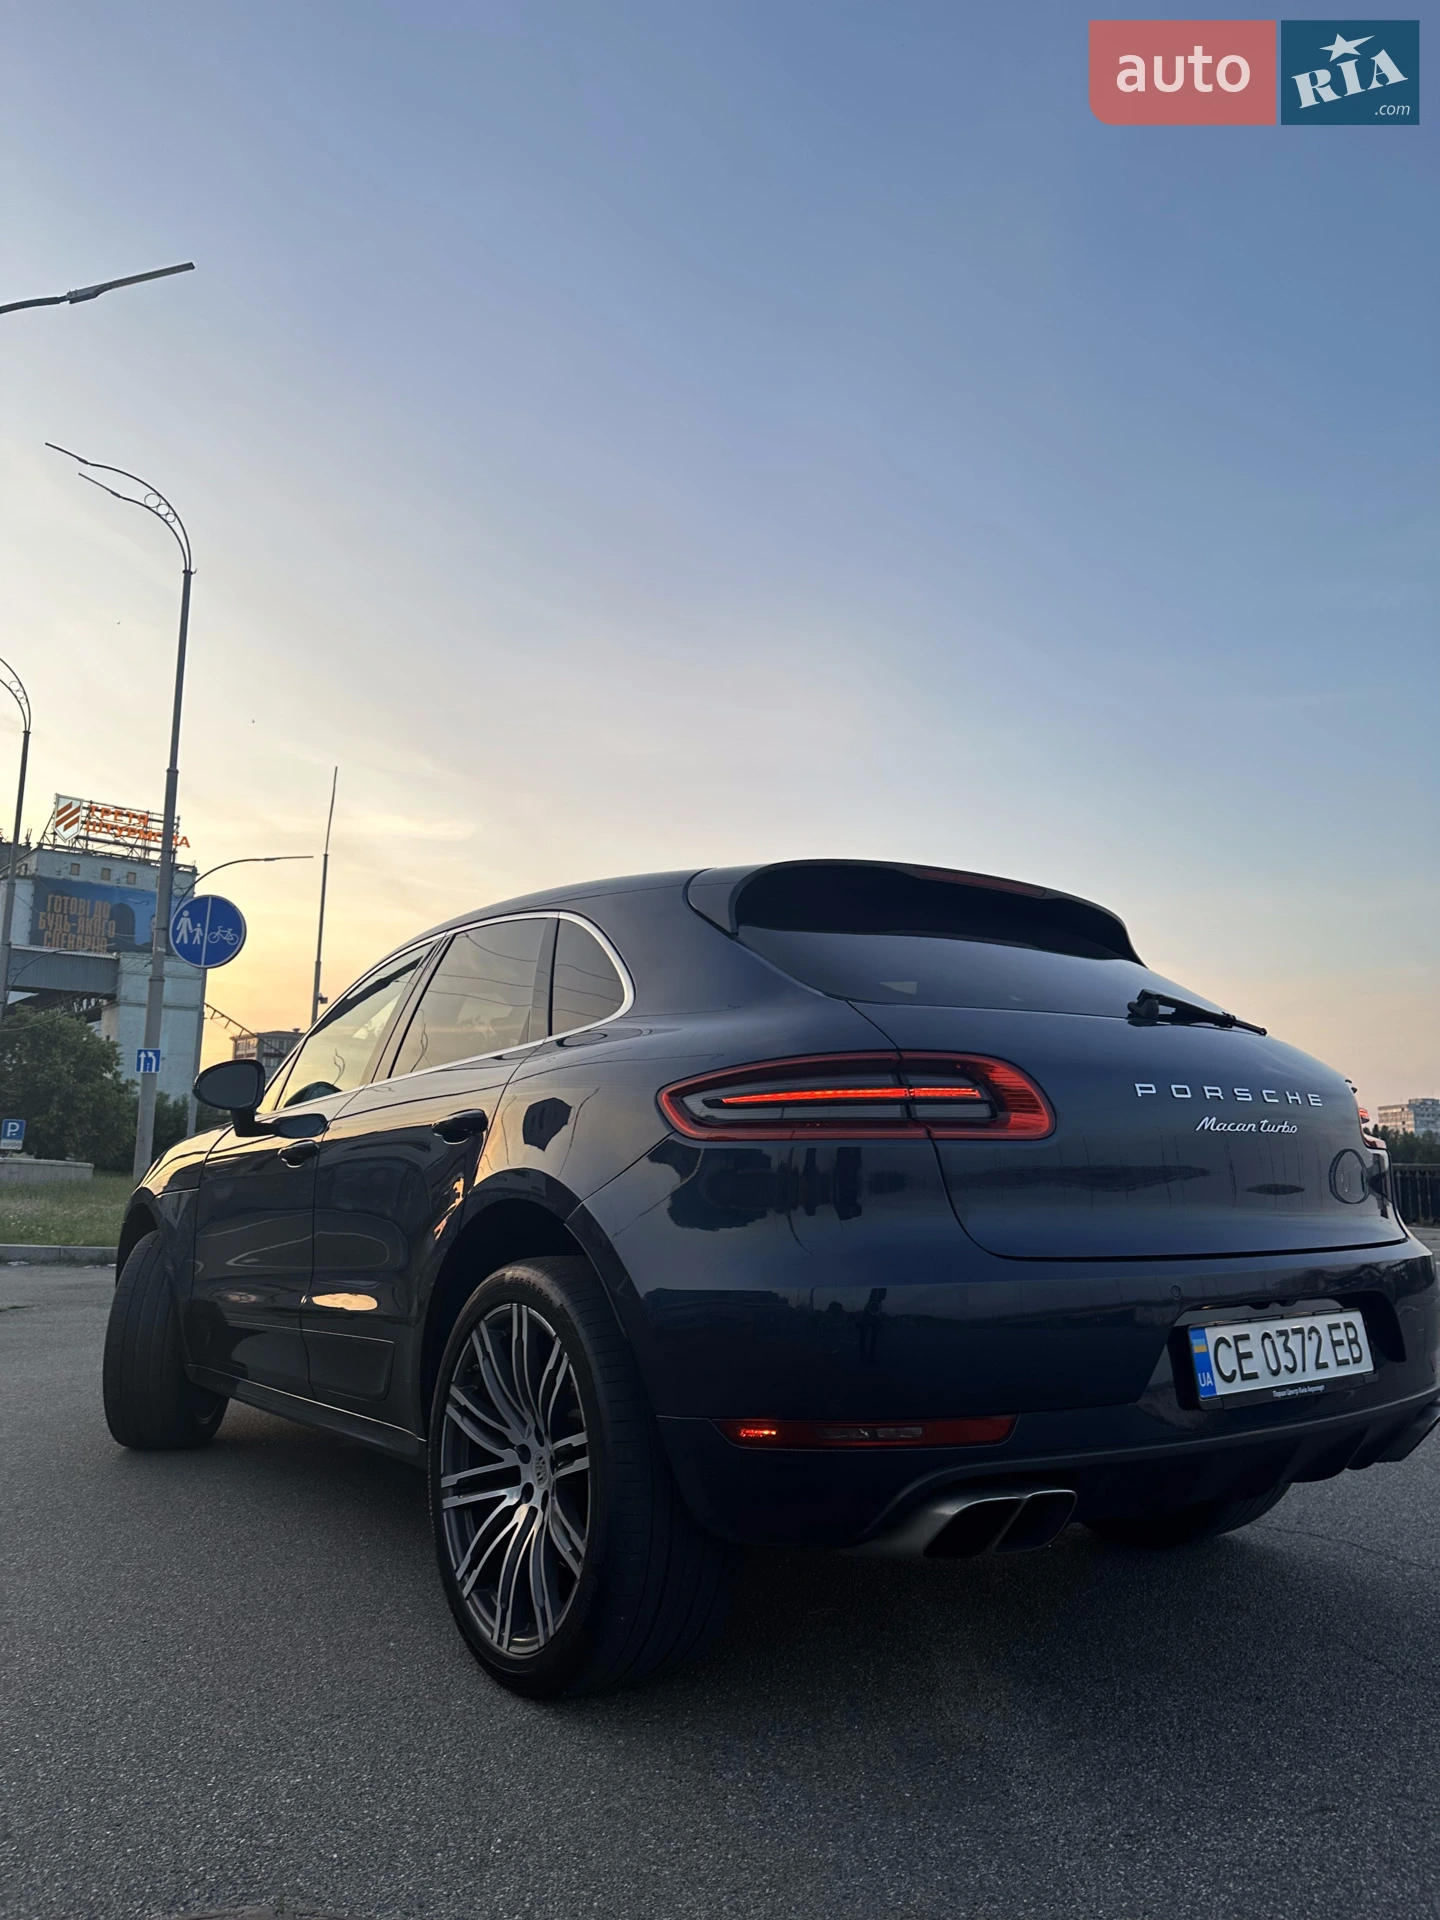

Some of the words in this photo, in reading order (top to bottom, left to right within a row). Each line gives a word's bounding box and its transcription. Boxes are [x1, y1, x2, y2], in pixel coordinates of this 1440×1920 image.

[88, 804, 149, 827] ТРЕТЯ
[46, 894, 91, 916] ГОТОВІ
[93, 899, 111, 919] ДО
[38, 911, 116, 938] БУДЬ-ЯКОГО
[1134, 1083, 1323, 1107] PORSCHE
[6, 1122, 20, 1137] P
[1195, 1116, 1256, 1133] Macan
[1259, 1118, 1298, 1134] turbo
[1213, 1333, 1259, 1384] CE
[1261, 1325, 1329, 1376] 0372
[1327, 1321, 1363, 1366] EB
[1198, 1372, 1214, 1388] UA
